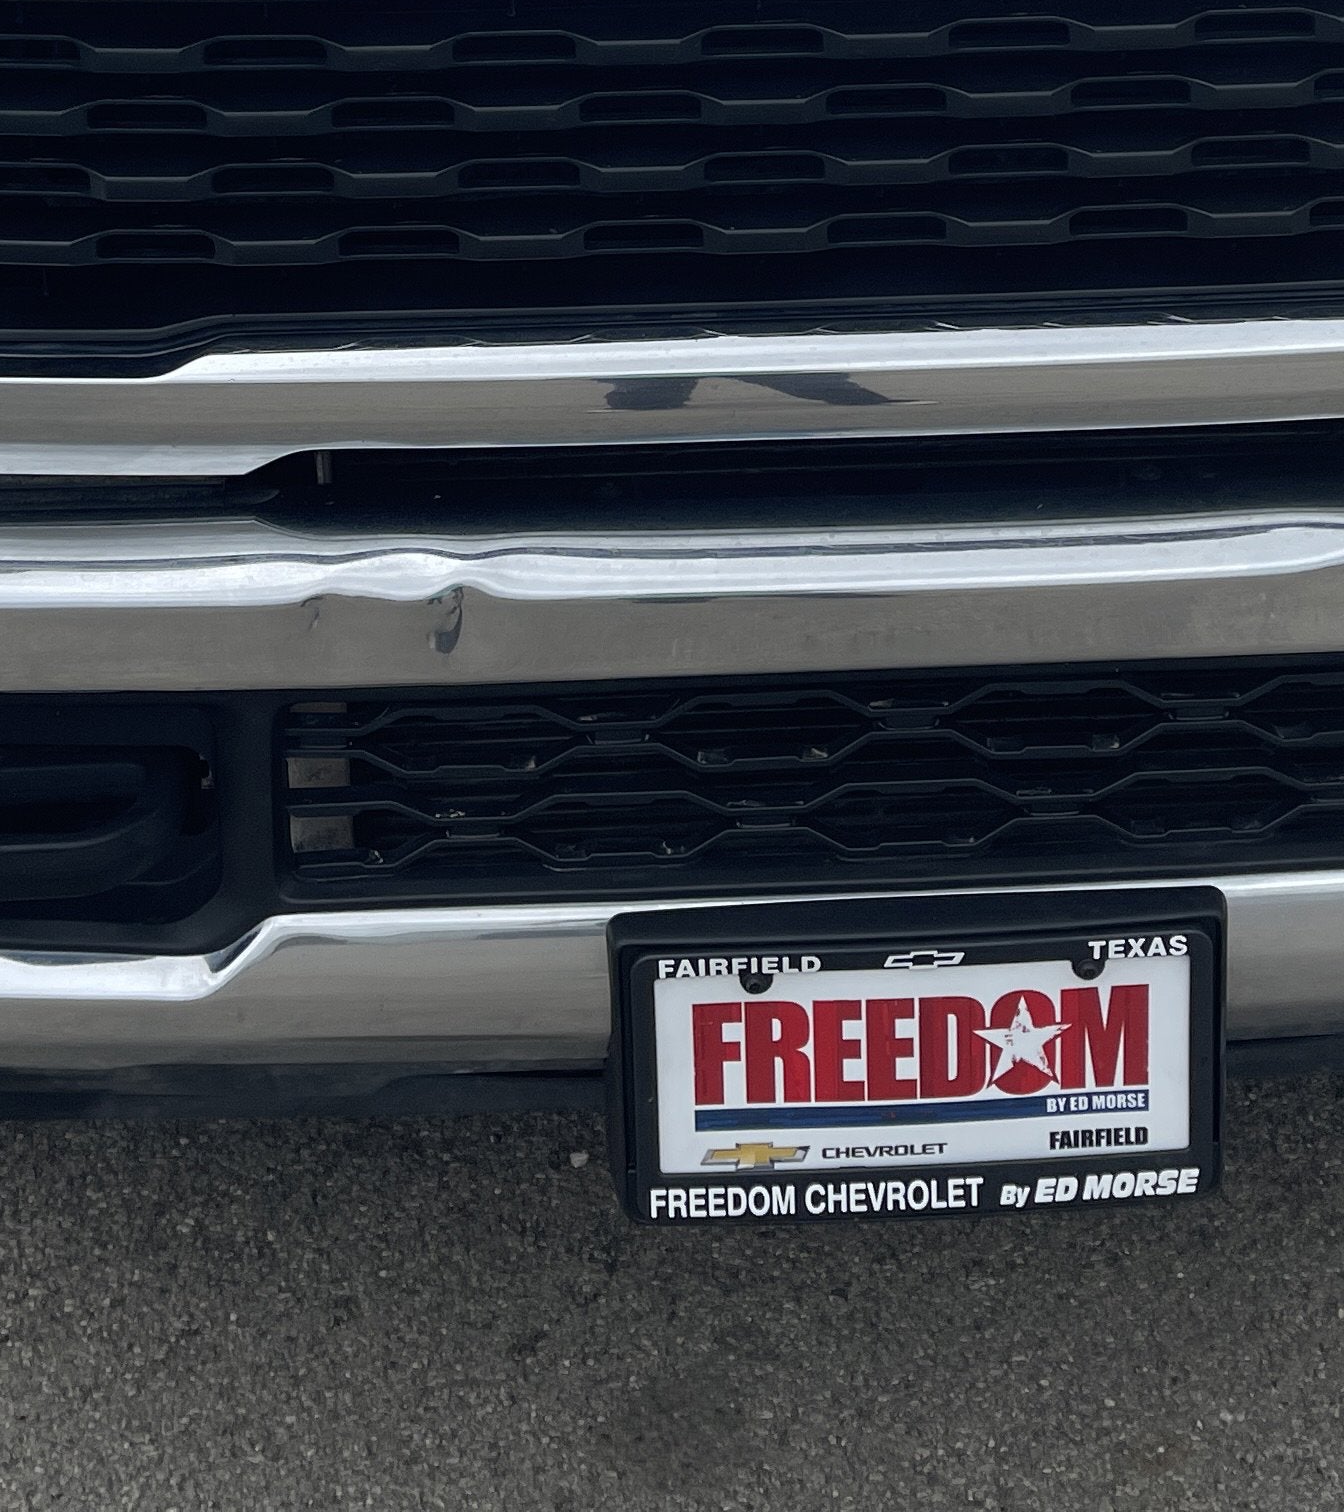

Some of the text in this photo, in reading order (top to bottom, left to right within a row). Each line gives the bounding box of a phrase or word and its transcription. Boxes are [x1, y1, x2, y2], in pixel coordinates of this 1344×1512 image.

[1088, 935, 1188, 960] TEXAS
[658, 955, 822, 979] FAIRFIELD
[692, 983, 1149, 1106] FREEDOM
[1046, 1093, 1146, 1113] BY ED MORSE
[1049, 1126, 1149, 1150] FAIRFIELD
[821, 1143, 948, 1159] CHEVROLET
[650, 1167, 1200, 1218] FREEDOM CHEVROLET By ED MORSE
